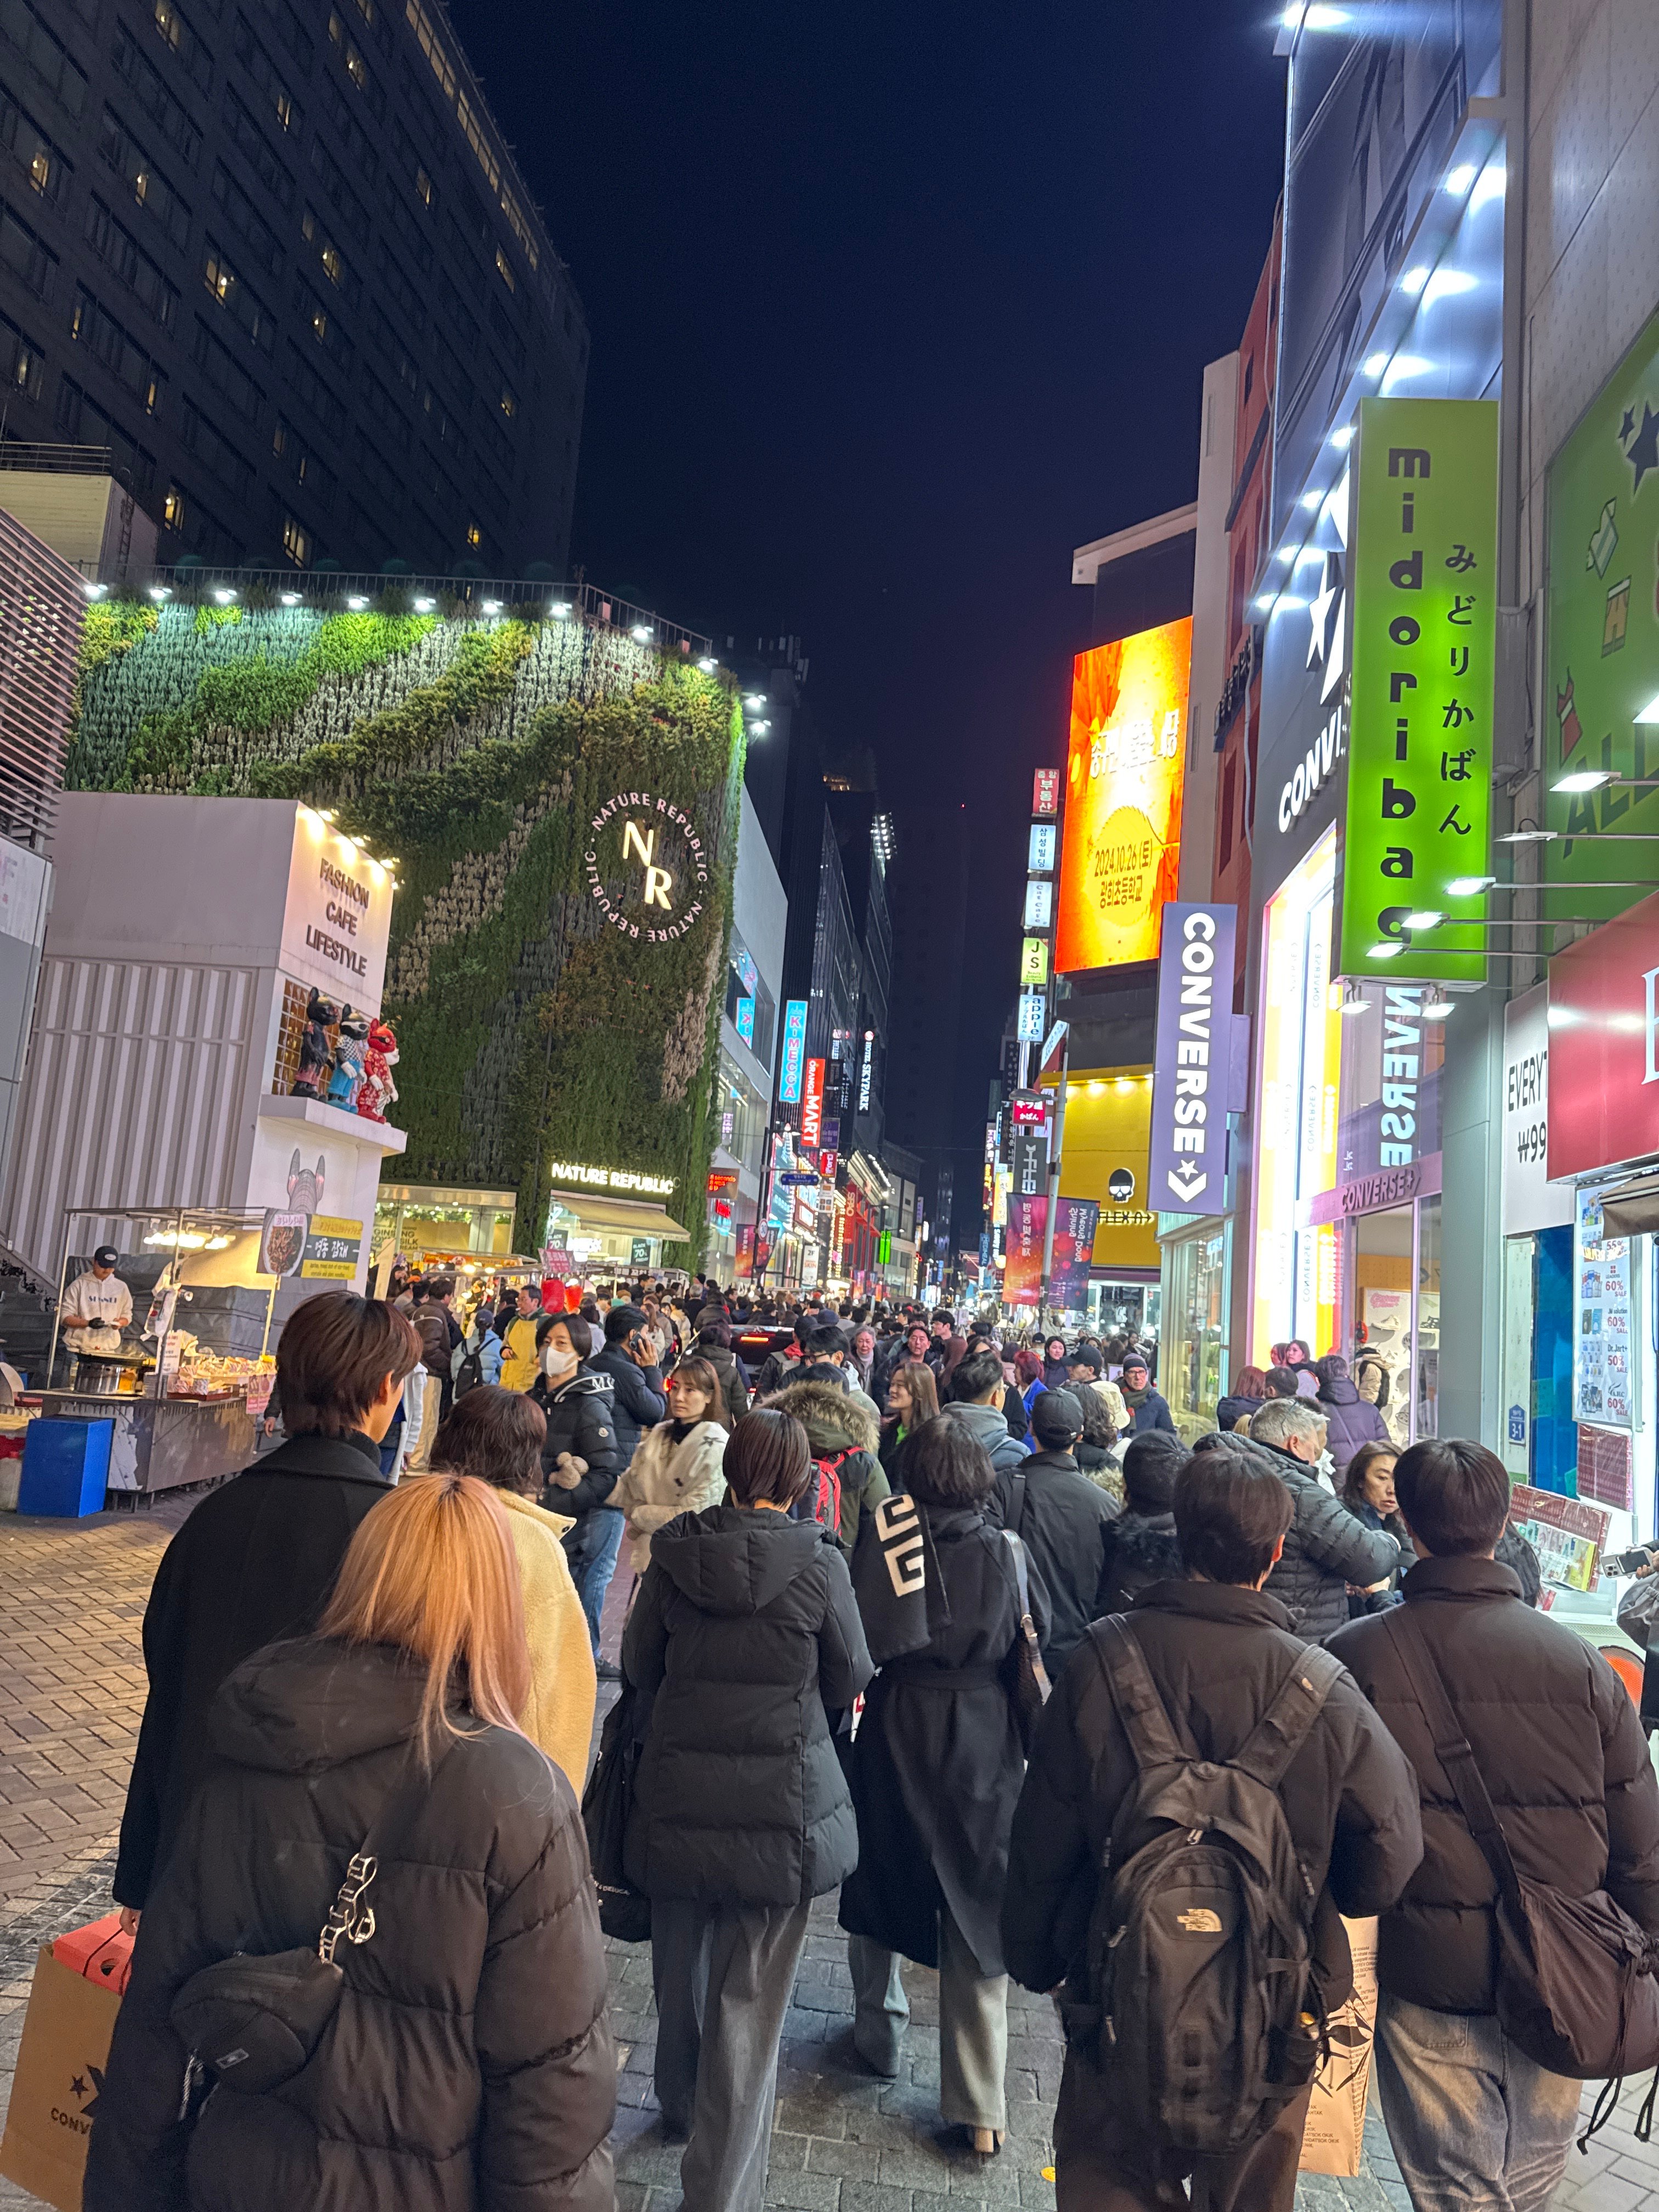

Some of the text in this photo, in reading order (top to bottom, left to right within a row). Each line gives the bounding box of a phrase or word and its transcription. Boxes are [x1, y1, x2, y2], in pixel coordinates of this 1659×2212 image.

[1377, 448, 1430, 945] midoribag
[1438, 544, 1476, 836] みどりかばん
[1279, 705, 1342, 833] CONV
[1039, 780, 1053, 813] 부동산
[585, 792, 708, 942] NATURE REPUBLIC NATURE REPUBLIC
[1037, 828, 1048, 868] 삼성빌딩
[1094, 844, 1137, 877] 2024.10.26
[320, 858, 370, 910] FASHION
[1100, 874, 1143, 909] 광희초등학교
[326, 901, 358, 936] CAFE
[306, 924, 368, 977] LIFESTYLE
[1030, 997, 1041, 1035] apple
[1173, 912, 1216, 1153] CONVERSE
[785, 1016, 800, 1098] KIMECCA
[859, 1041, 872, 1111] HOTEL SKYPARK
[802, 1060, 820, 1145] ORANGE MART
[551, 1163, 608, 1185] NATURE
[610, 1171, 674, 1194] REPUBLIC
[1342, 1169, 1408, 1213] CONVERSE
[315, 1237, 329, 1259] 명동
[331, 1240, 349, 1259] 잡채
[1605, 1280, 1624, 1291] 60%
[1607, 1316, 1626, 1327] 60%
[1607, 1355, 1624, 1366] 50%
[1607, 1397, 1625, 1409] 60%
[1511, 1423, 1522, 1438] 3-1
[50, 2108, 90, 2135] CONV
